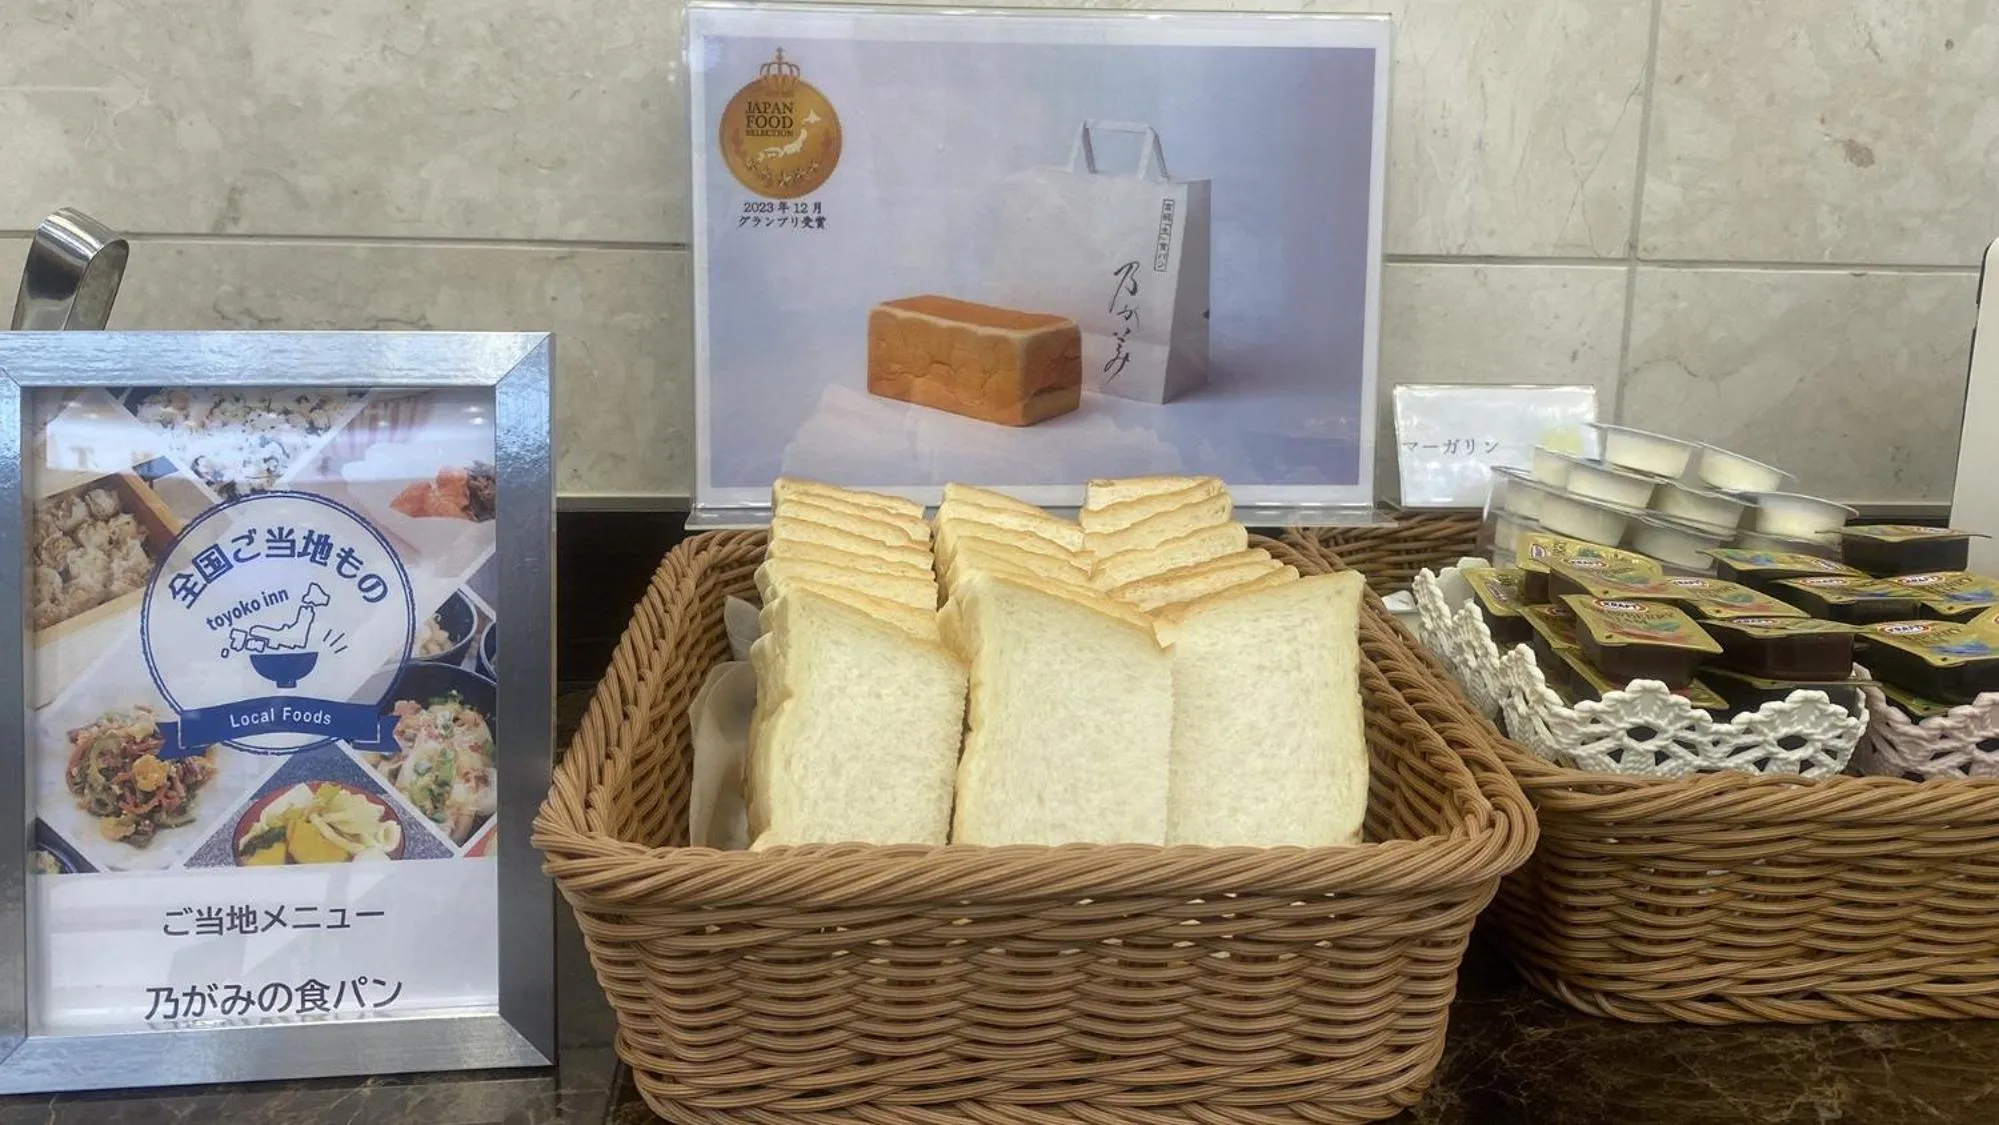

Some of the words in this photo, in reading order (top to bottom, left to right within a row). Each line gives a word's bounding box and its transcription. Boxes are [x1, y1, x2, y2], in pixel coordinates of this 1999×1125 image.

[745, 101, 794, 114] JAPAN
[746, 115, 794, 129] FOOD
[738, 215, 827, 229] グランプリ受賞
[1402, 438, 1499, 454] マーガリン
[168, 526, 389, 609] 全国ご当地もの
[206, 597, 261, 631] toyoko
[262, 587, 289, 607] inn
[230, 710, 275, 728] Local
[282, 707, 332, 725] Foods
[163, 904, 385, 936] ご当地メニュー
[144, 976, 403, 1020] 乃がみの食パン
